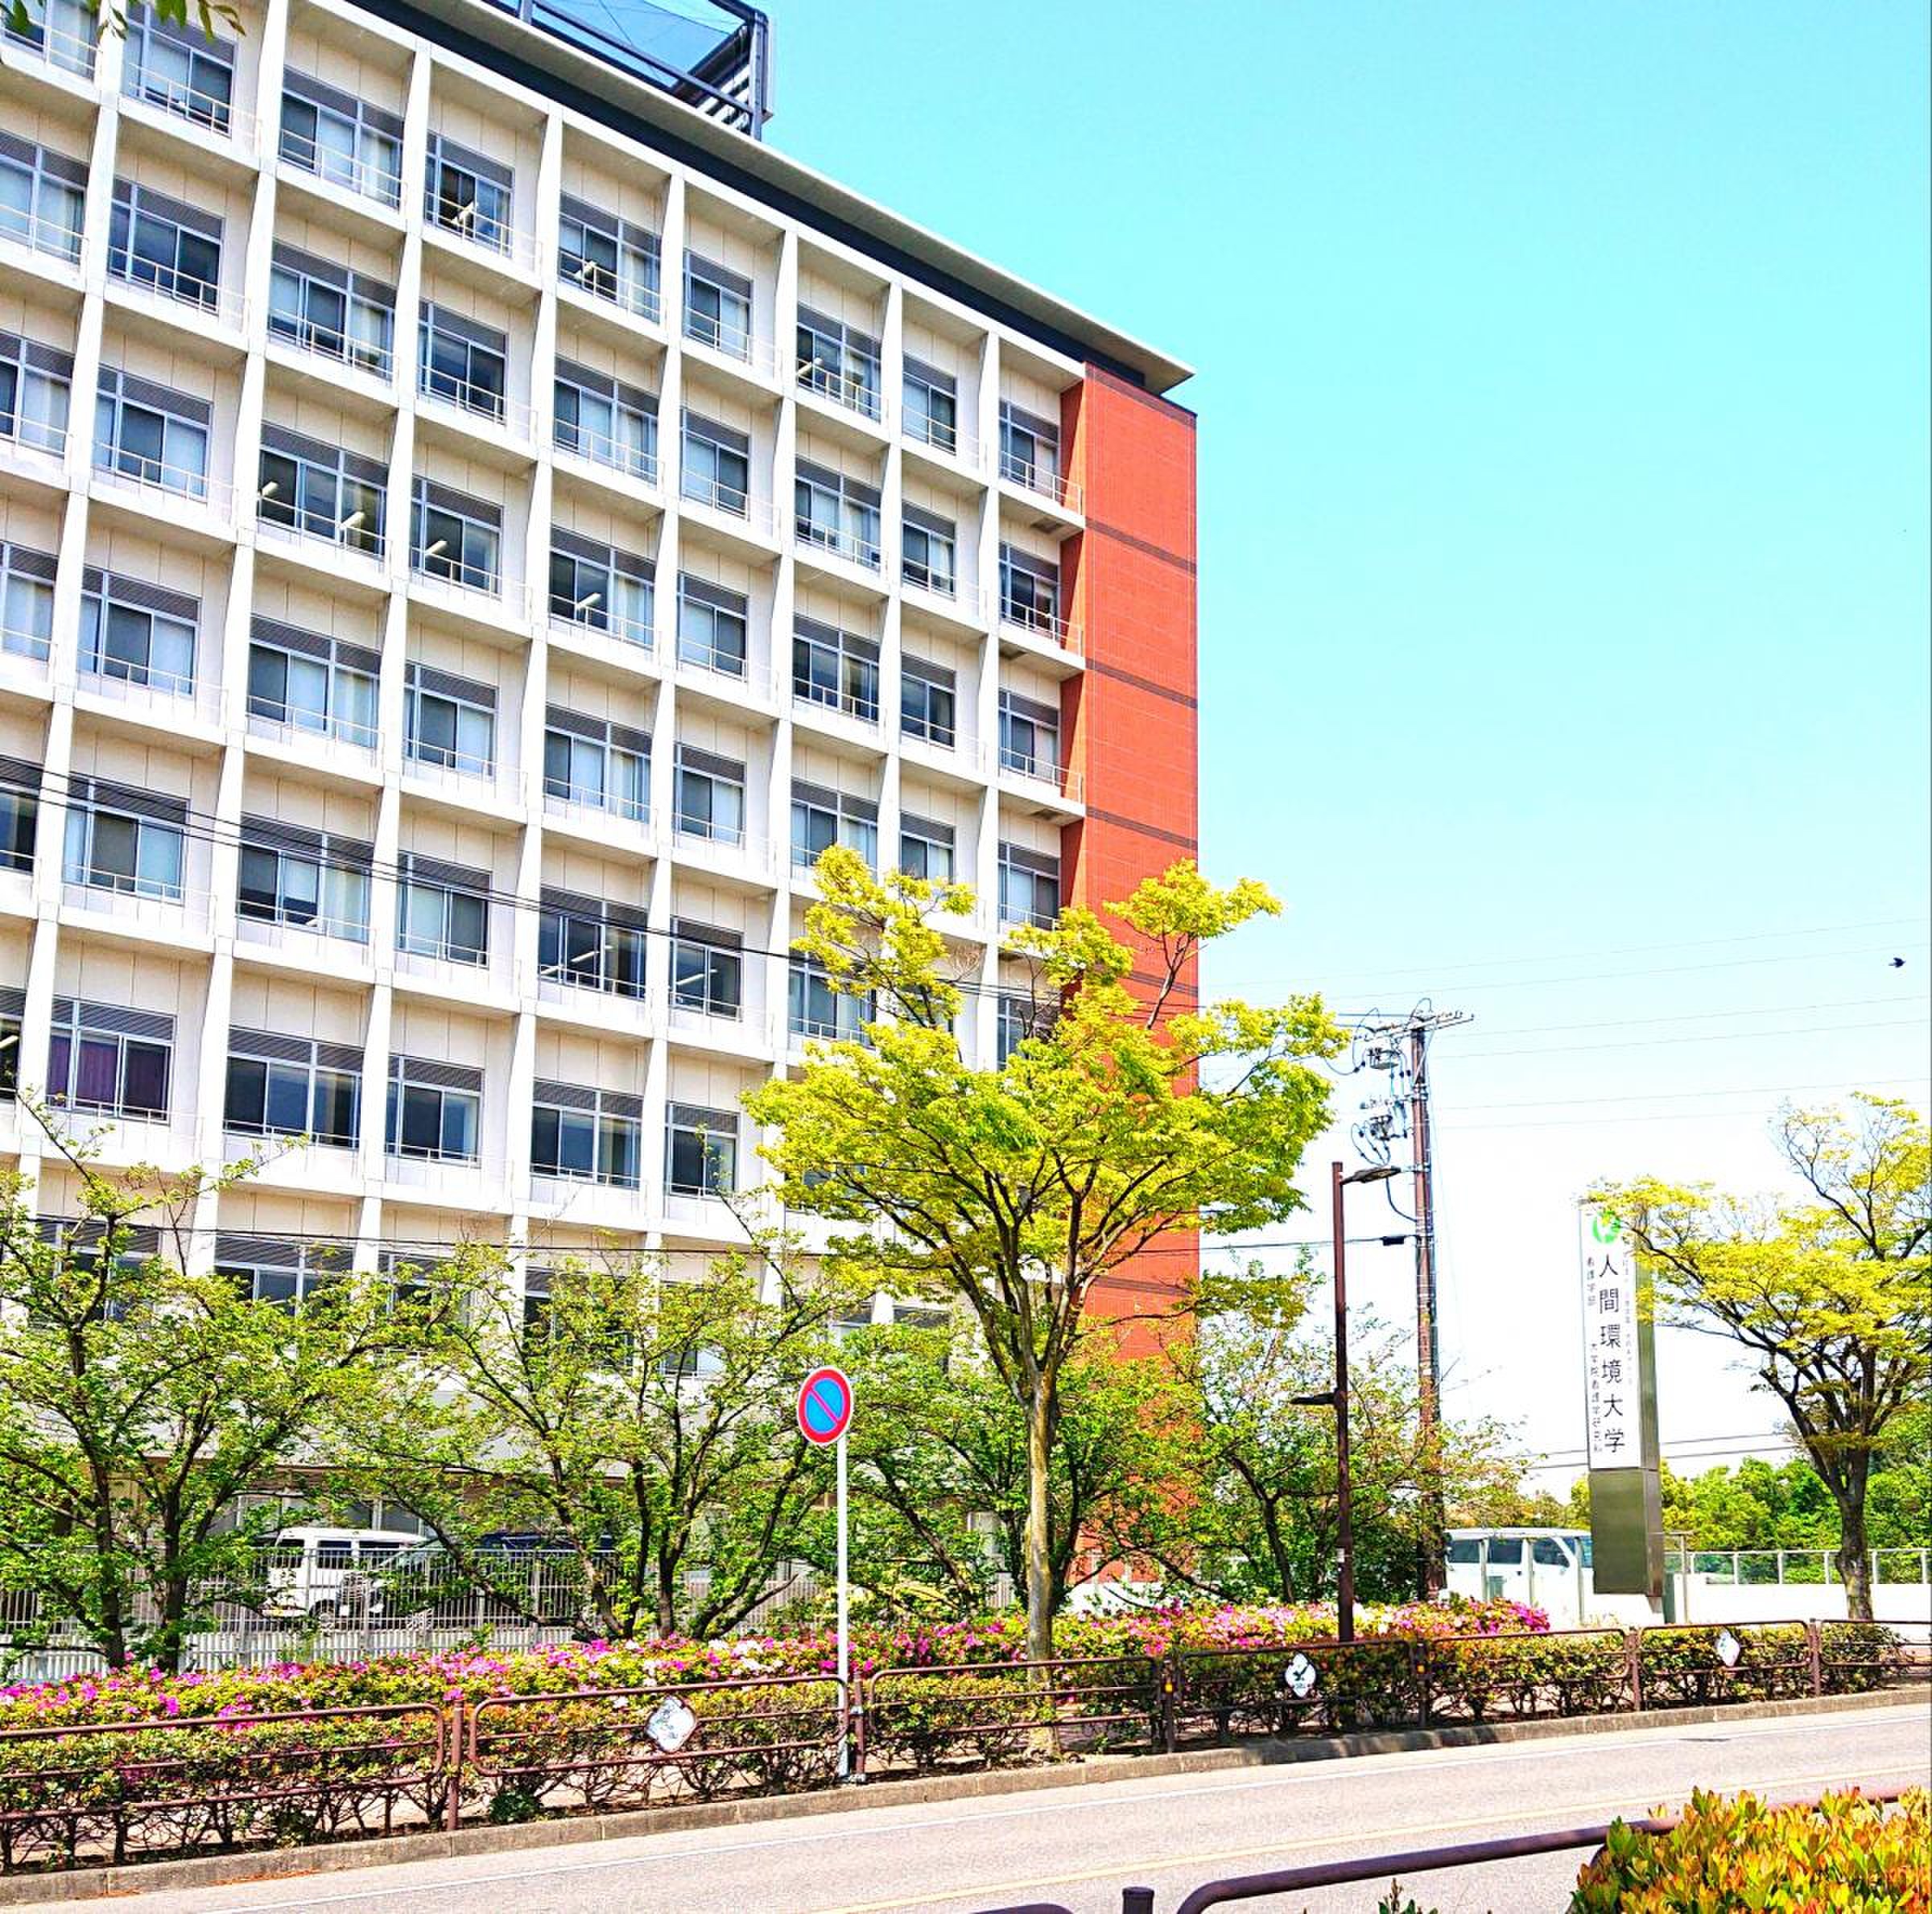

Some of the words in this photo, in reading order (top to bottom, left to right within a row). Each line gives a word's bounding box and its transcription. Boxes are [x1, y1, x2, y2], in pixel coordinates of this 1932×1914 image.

[1599, 1254, 1625, 1453] 人間環境大学
